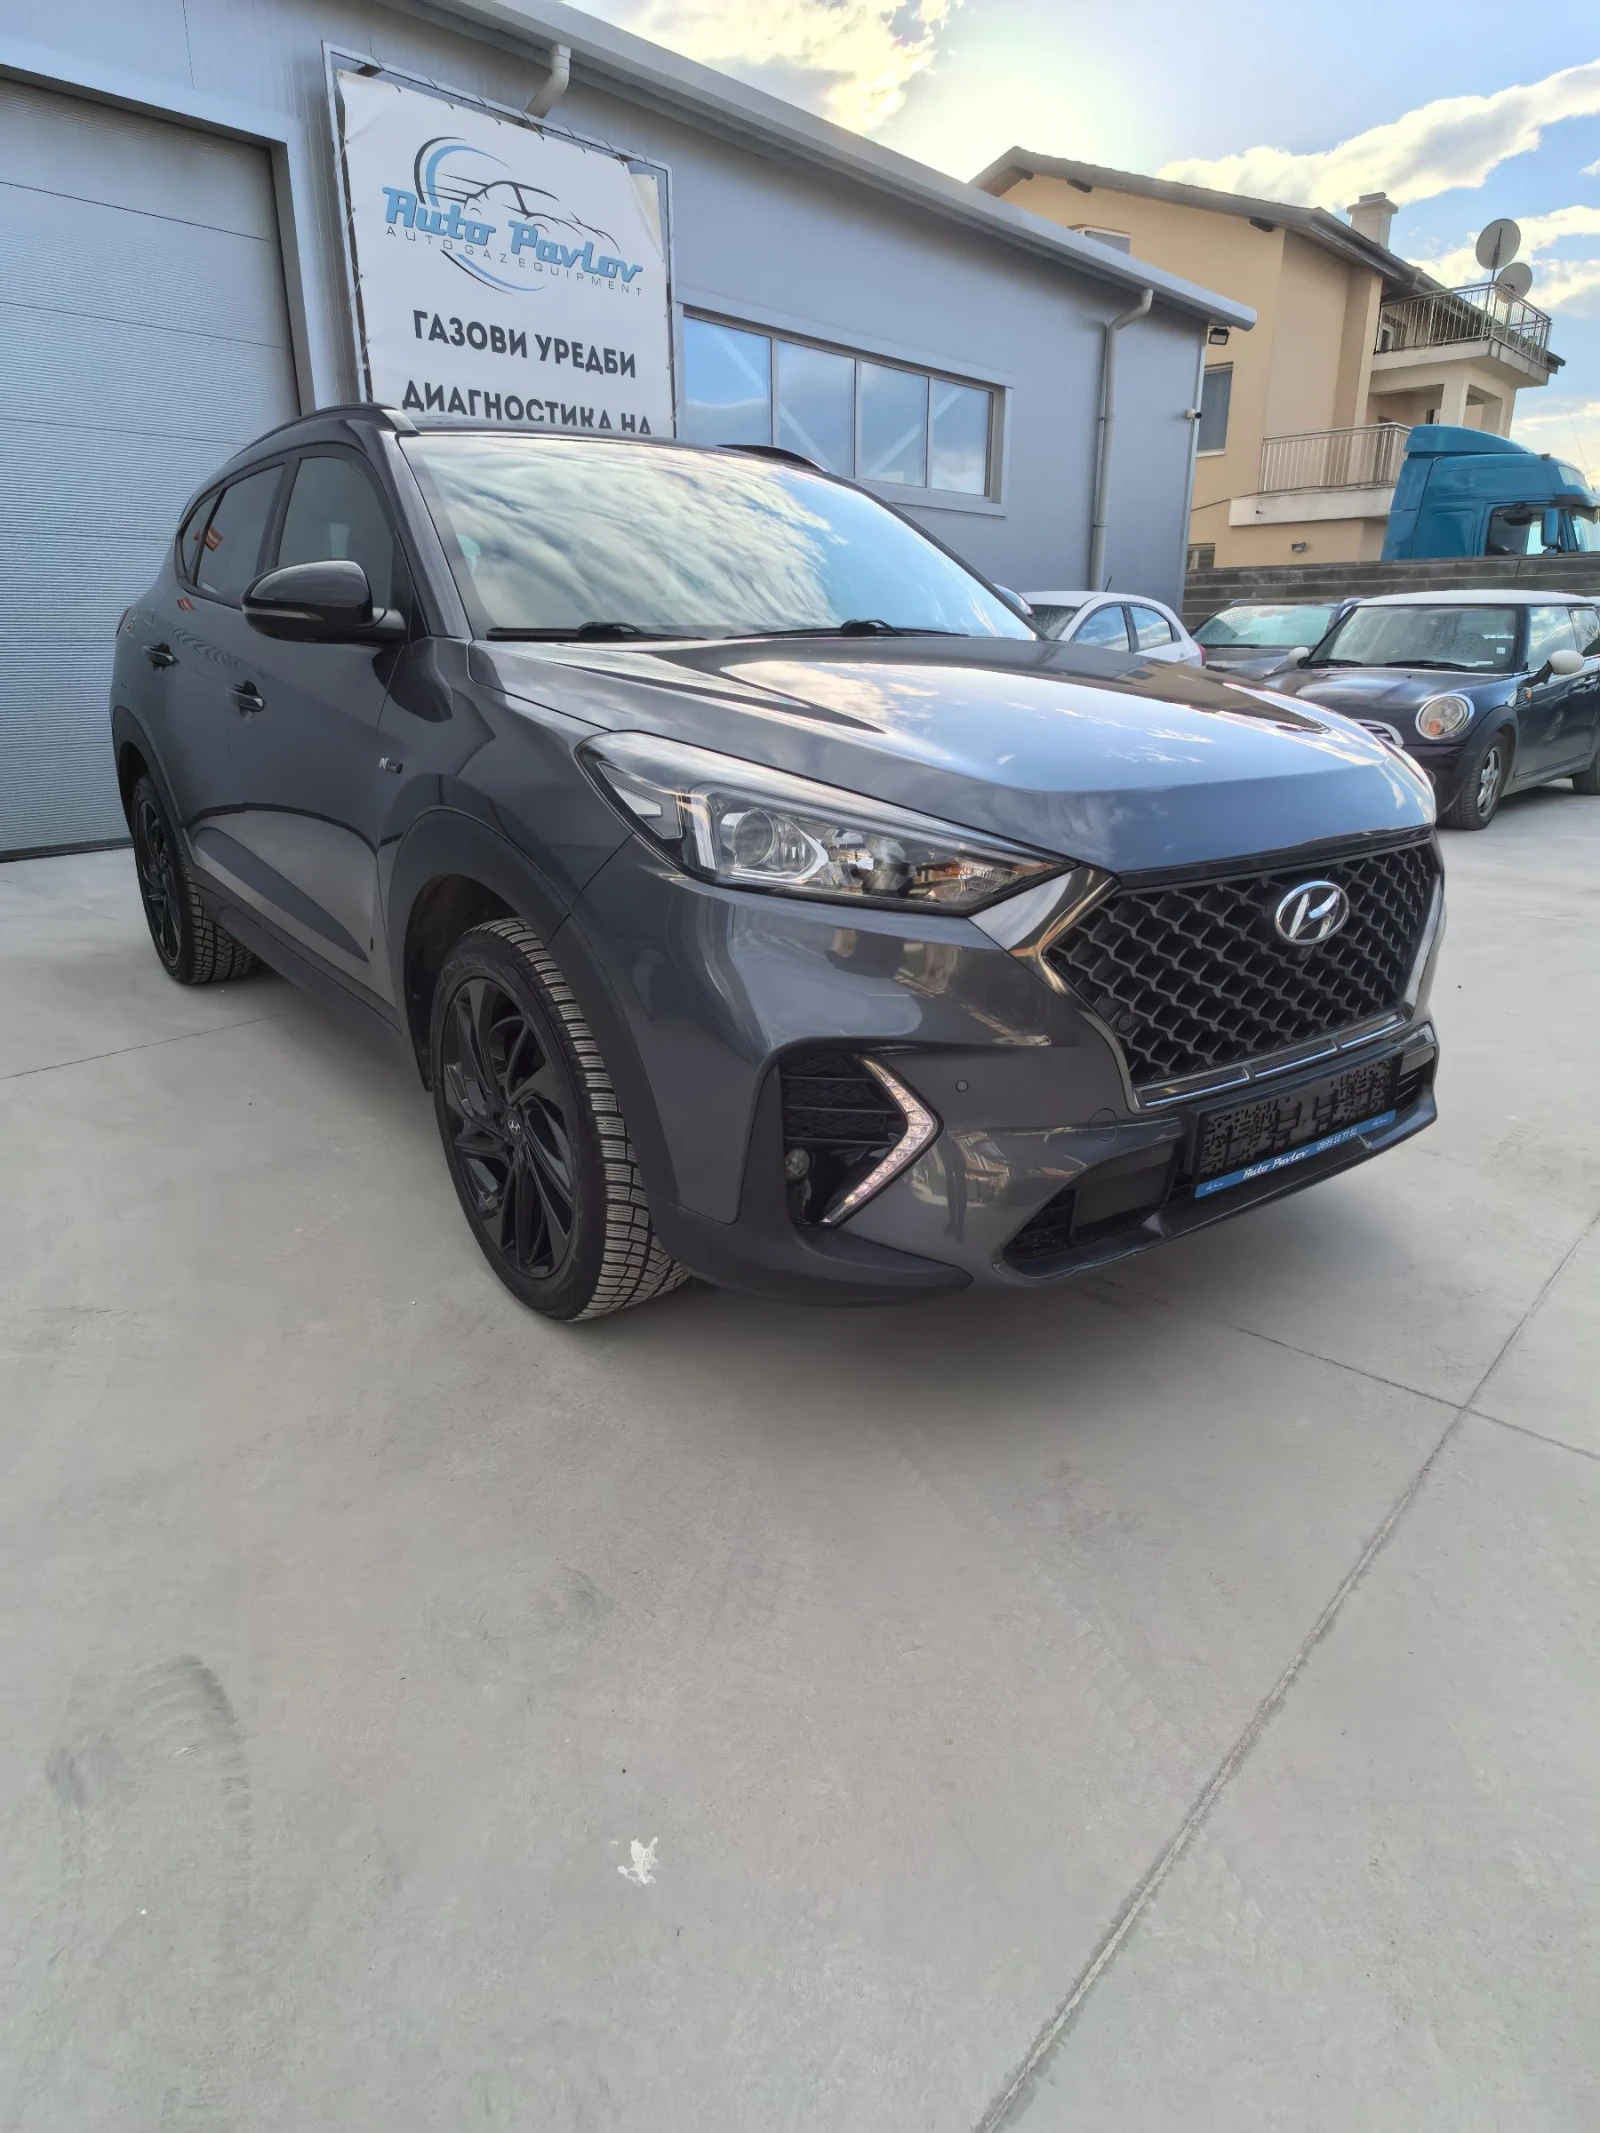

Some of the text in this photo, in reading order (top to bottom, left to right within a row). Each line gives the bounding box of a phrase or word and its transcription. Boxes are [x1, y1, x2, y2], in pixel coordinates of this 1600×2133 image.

[382, 186, 643, 283] Auto Pavlov
[413, 310, 636, 378] ГАЗОВИ УРЕДБИ
[402, 380, 651, 435] ДИАГНОСТИКА НА
[1243, 1165, 1271, 1180] Auto
